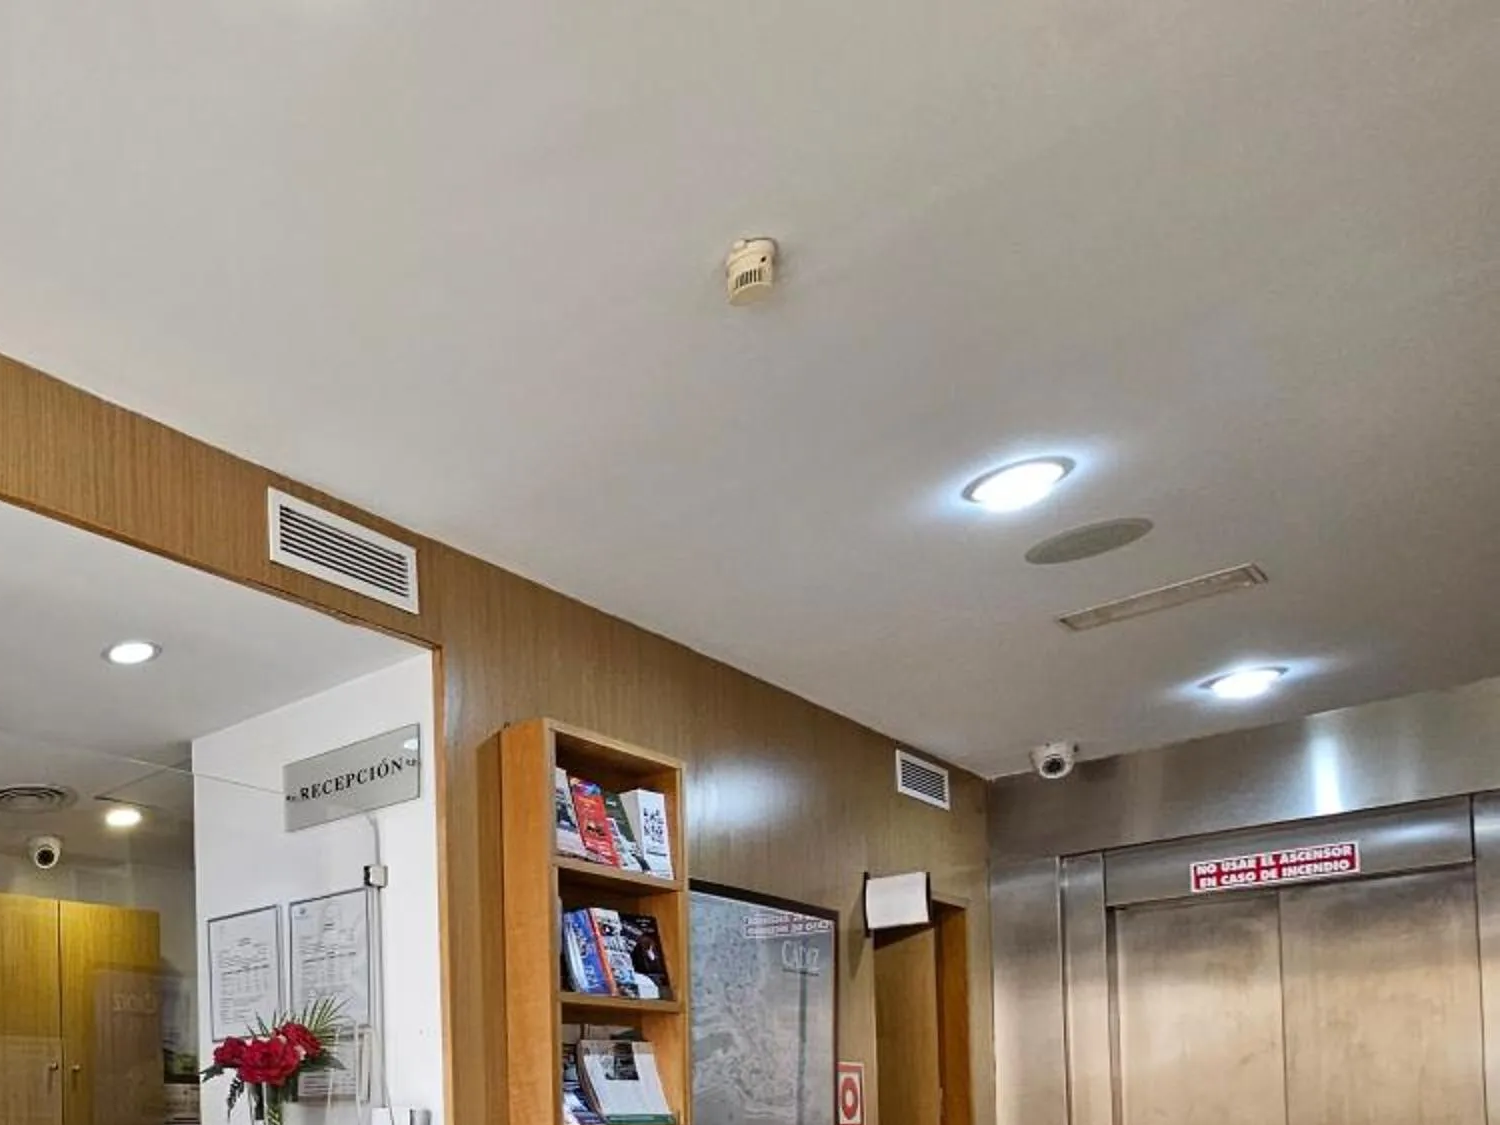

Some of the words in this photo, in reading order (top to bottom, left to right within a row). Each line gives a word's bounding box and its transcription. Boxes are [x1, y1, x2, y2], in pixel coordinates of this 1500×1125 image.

[300, 757, 403, 801] RECEPCIÓN
[1196, 863, 1217, 876] NO
[1221, 858, 1257, 872] USAR
[1260, 854, 1278, 867] EL
[1280, 845, 1353, 864] ASCENSOR
[1199, 876, 1218, 889] EN
[1220, 871, 1257, 886] CASO
[1260, 868, 1279, 880] DE
[1282, 859, 1350, 877] INCENDIO
